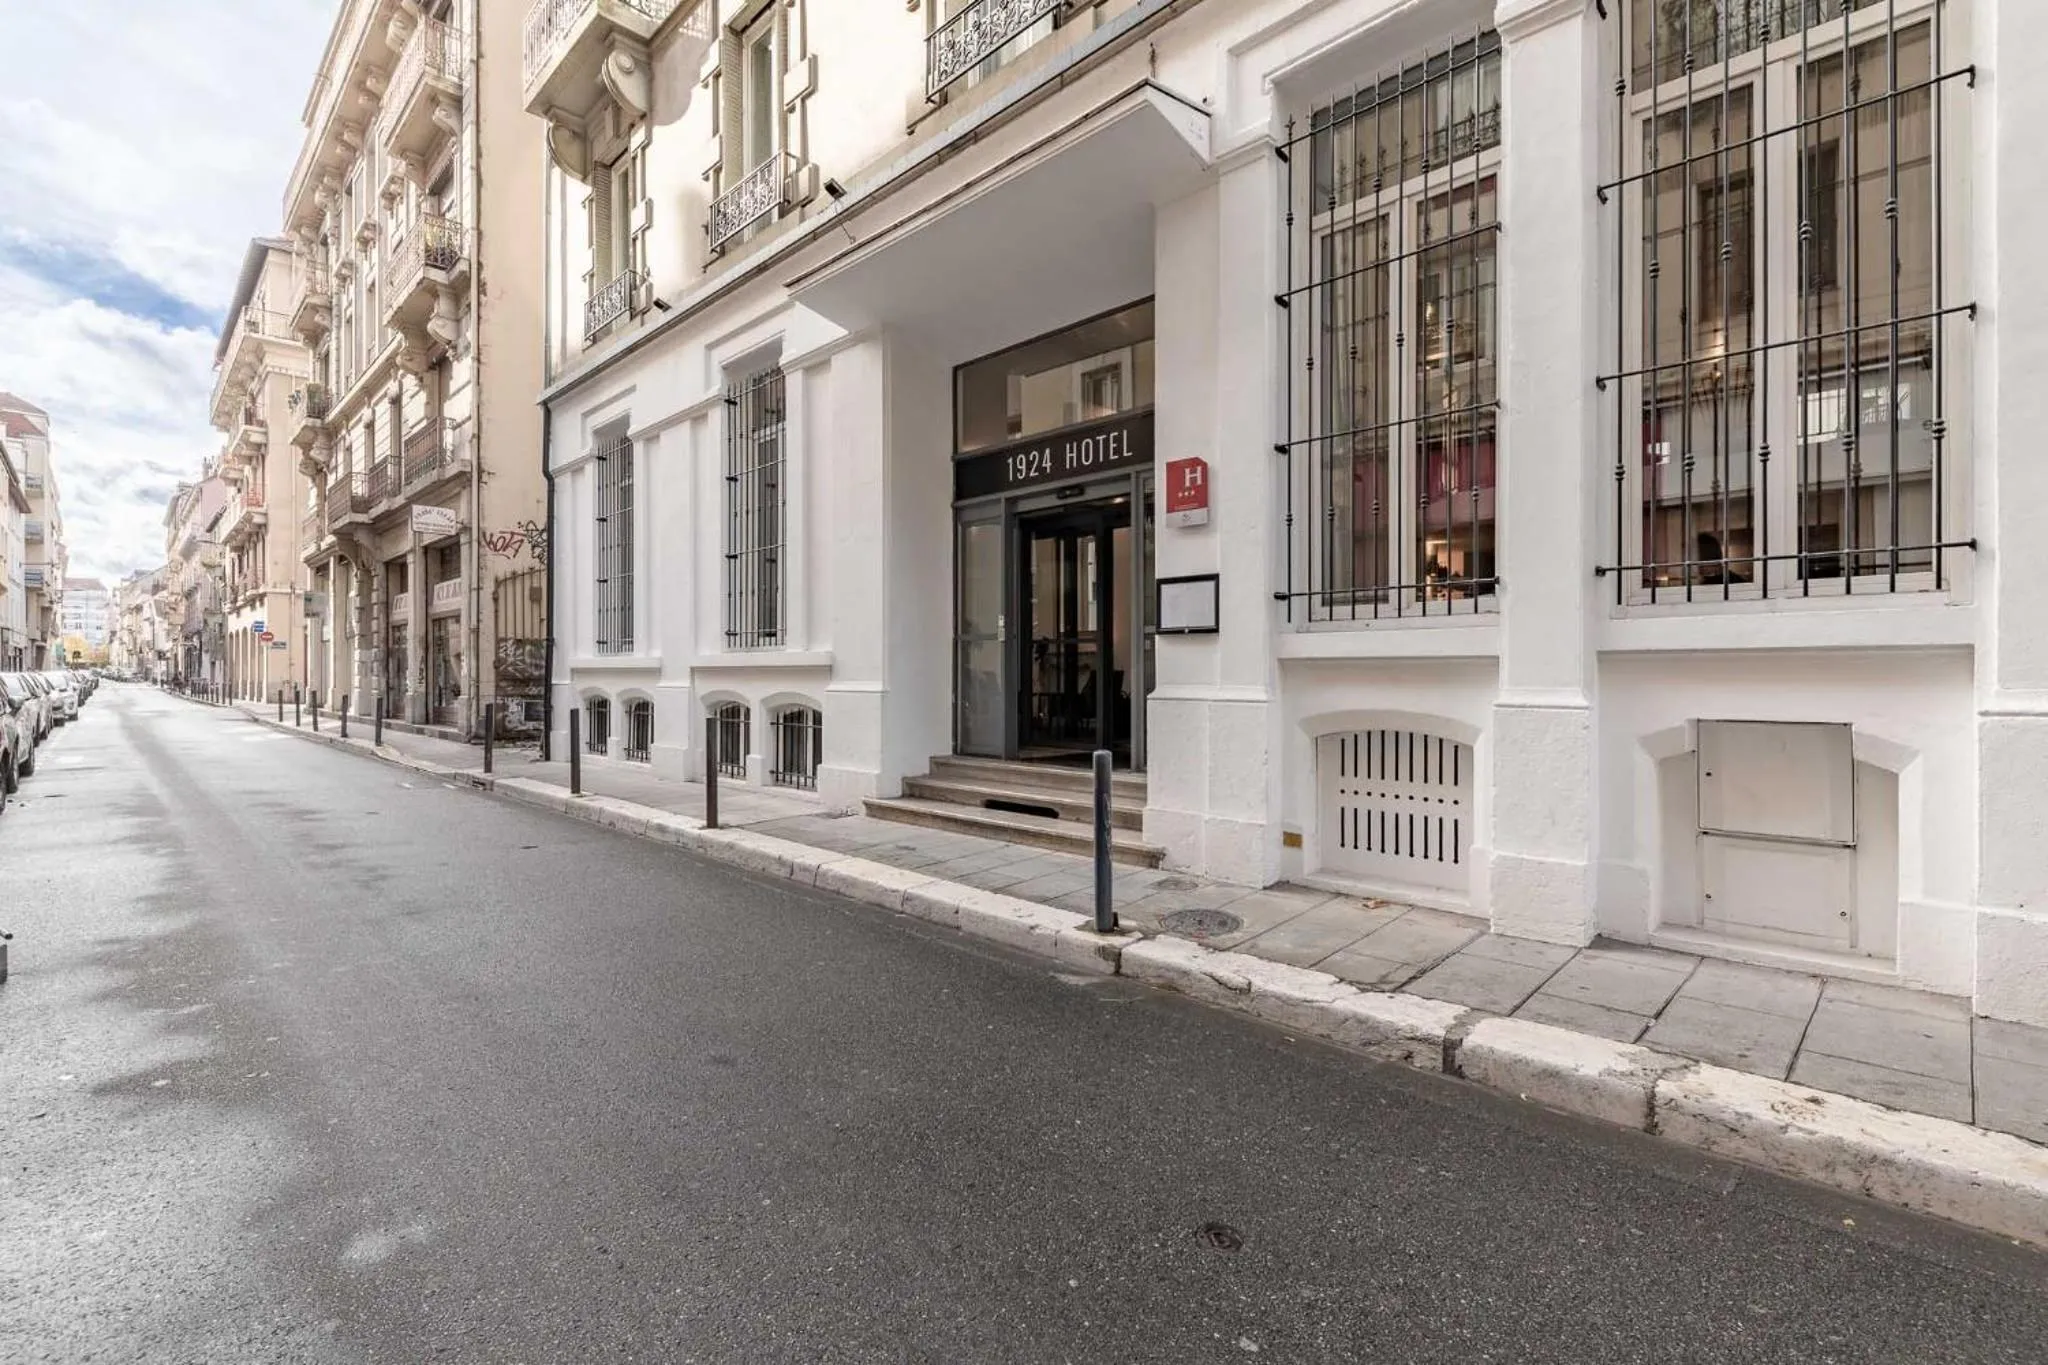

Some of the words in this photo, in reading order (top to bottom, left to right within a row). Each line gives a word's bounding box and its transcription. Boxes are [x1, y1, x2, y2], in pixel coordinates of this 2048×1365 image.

[1007, 447, 1052, 482] 1924
[1065, 429, 1133, 469] HOTEL
[1184, 465, 1202, 487] H
